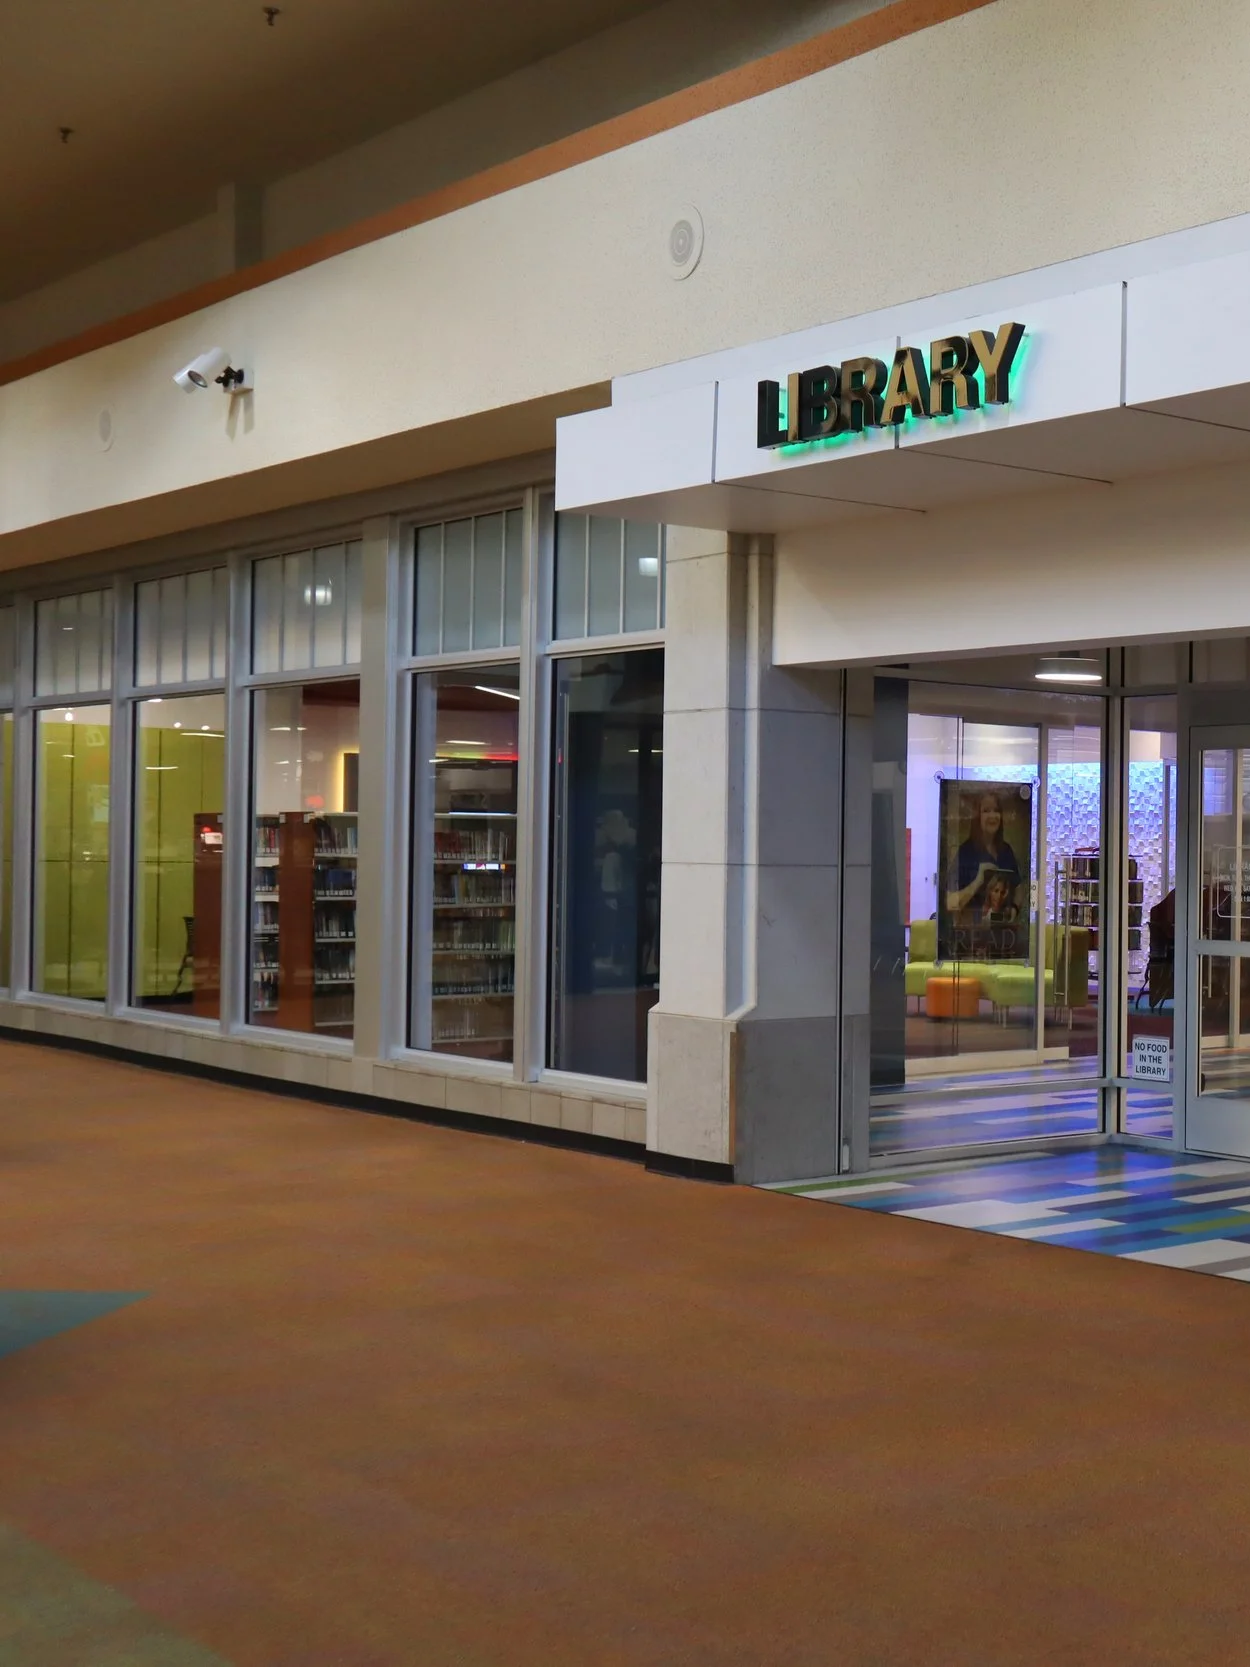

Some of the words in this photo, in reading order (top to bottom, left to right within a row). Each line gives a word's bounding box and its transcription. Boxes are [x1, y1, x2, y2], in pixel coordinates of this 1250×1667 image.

[758, 322, 1025, 449] LIBRARY
[954, 928, 1015, 950] READ
[1135, 1042, 1145, 1051] NO
[1147, 1044, 1167, 1053] FOOD
[1140, 1055, 1146, 1063] IN
[1148, 1055, 1162, 1064] THE
[1136, 1065, 1166, 1076] LIBRARY
